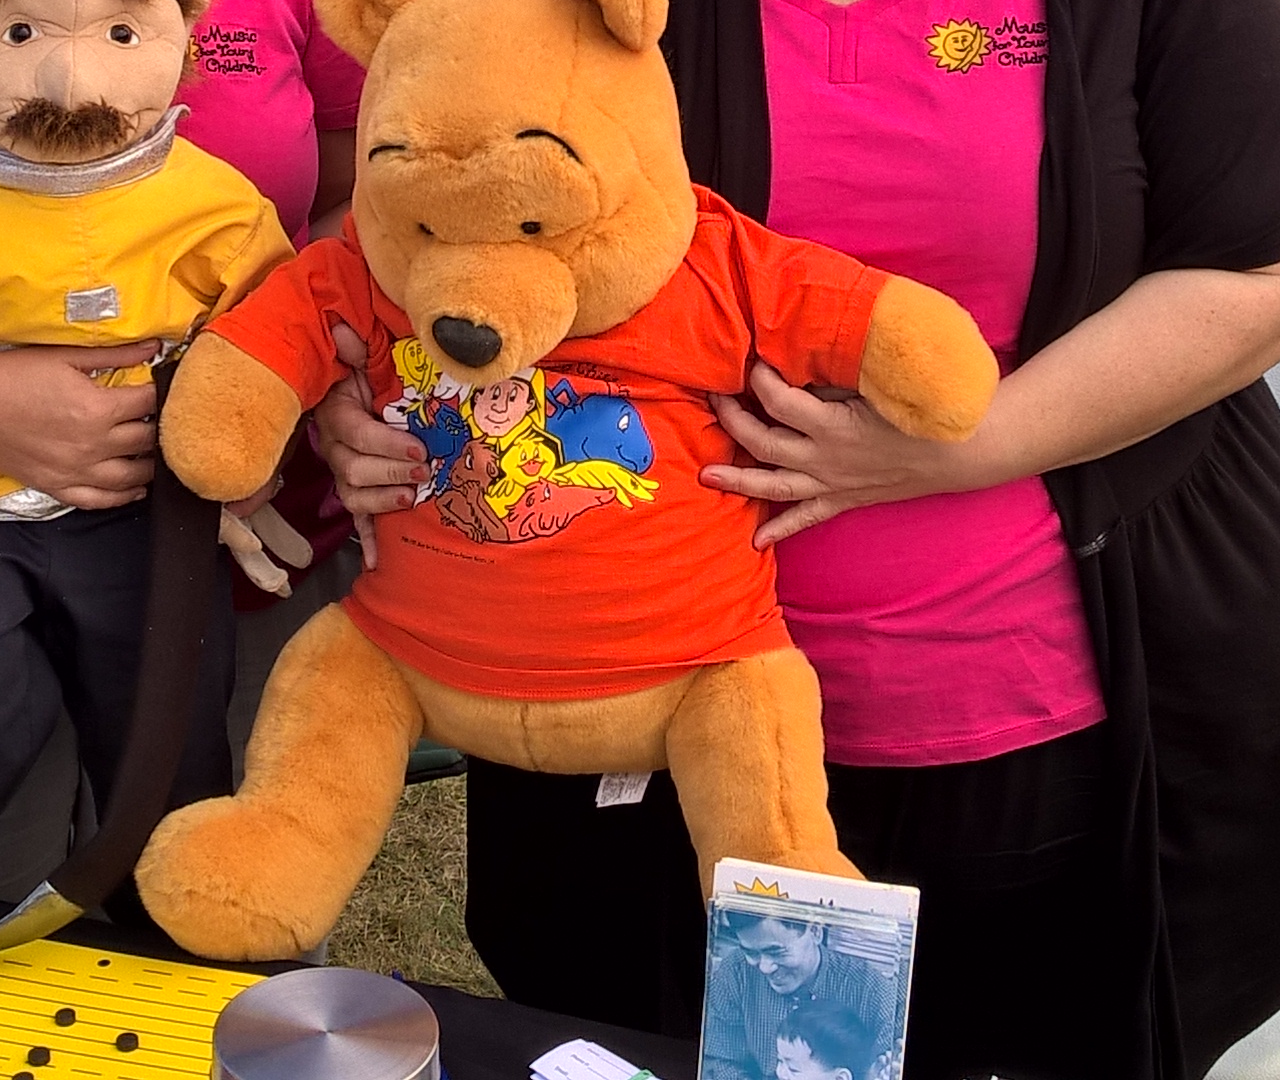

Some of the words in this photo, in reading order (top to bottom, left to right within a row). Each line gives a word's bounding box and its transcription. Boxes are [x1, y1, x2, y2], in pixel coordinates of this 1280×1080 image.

[201, 24, 257, 43] Music
[995, 16, 1048, 35] Mus
[216, 43, 255, 64] Young
